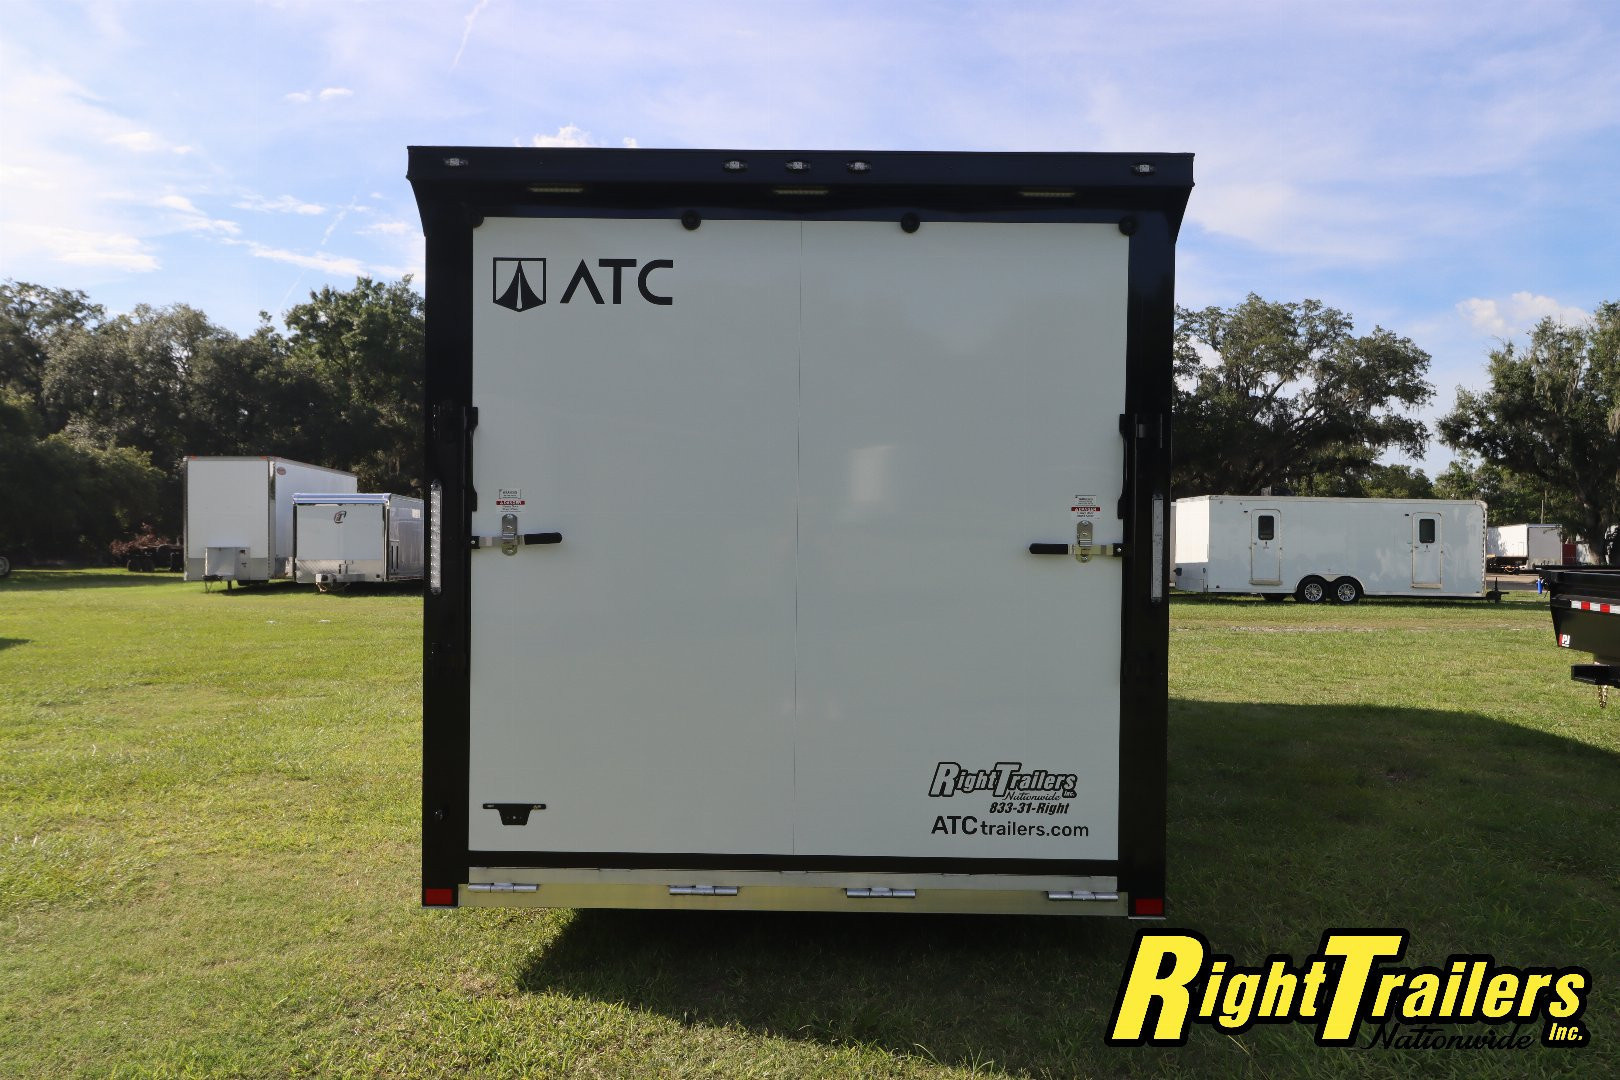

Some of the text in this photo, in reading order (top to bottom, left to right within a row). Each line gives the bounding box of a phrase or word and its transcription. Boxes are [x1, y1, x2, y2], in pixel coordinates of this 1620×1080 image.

[559, 258, 674, 305] ATC
[1002, 791, 1061, 801] Nationwide
[989, 802, 1070, 815] 833-31-Right
[931, 815, 1089, 837] ATCtrailers.com
